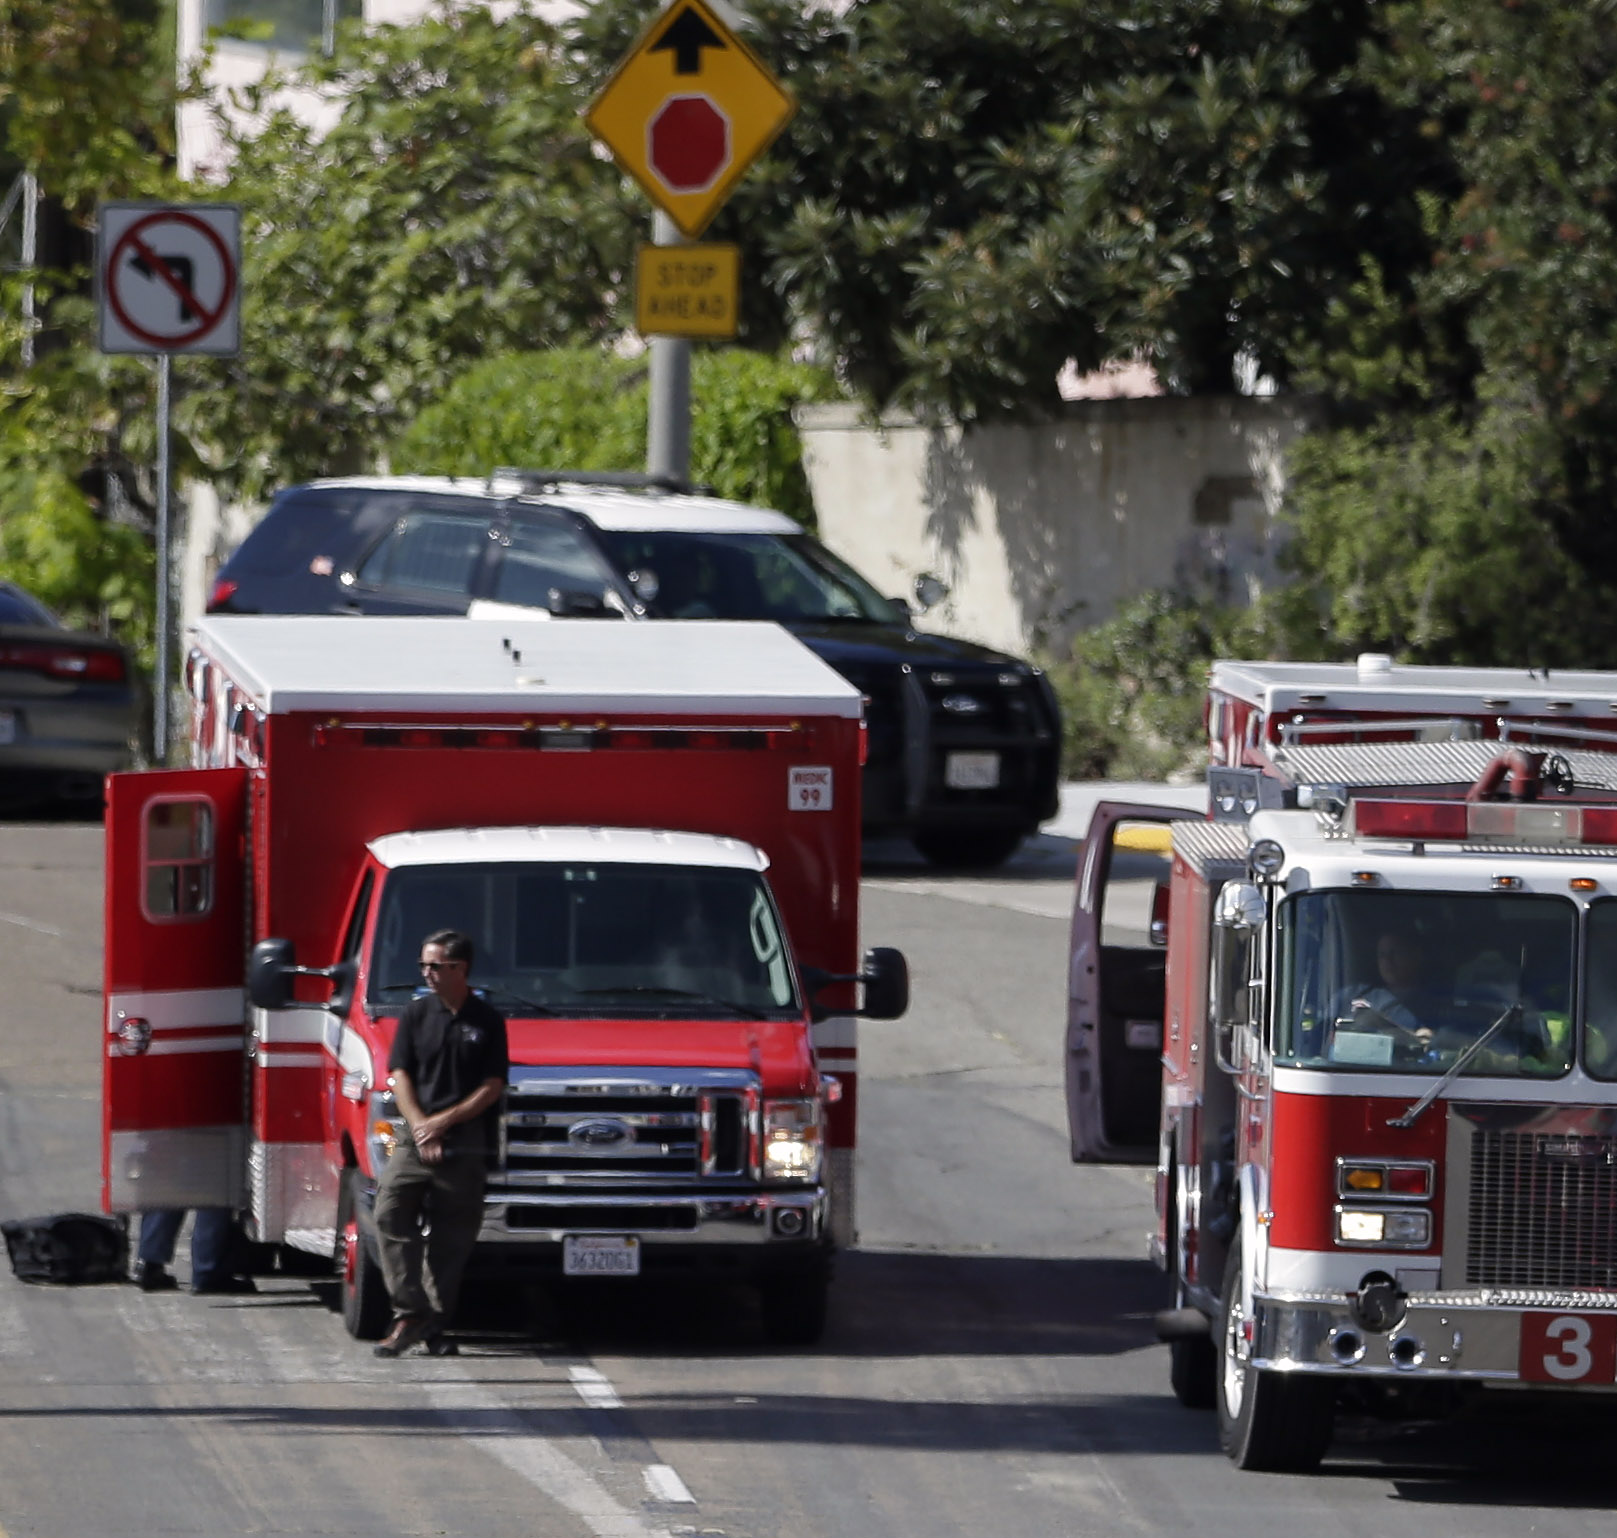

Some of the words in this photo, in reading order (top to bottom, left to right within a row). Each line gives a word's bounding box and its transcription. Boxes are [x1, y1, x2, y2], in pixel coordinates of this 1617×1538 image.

[658, 263, 717, 288] STOP
[648, 296, 726, 319] AHEAD
[800, 789, 821, 807] 99
[1543, 1315, 1592, 1380] 3
